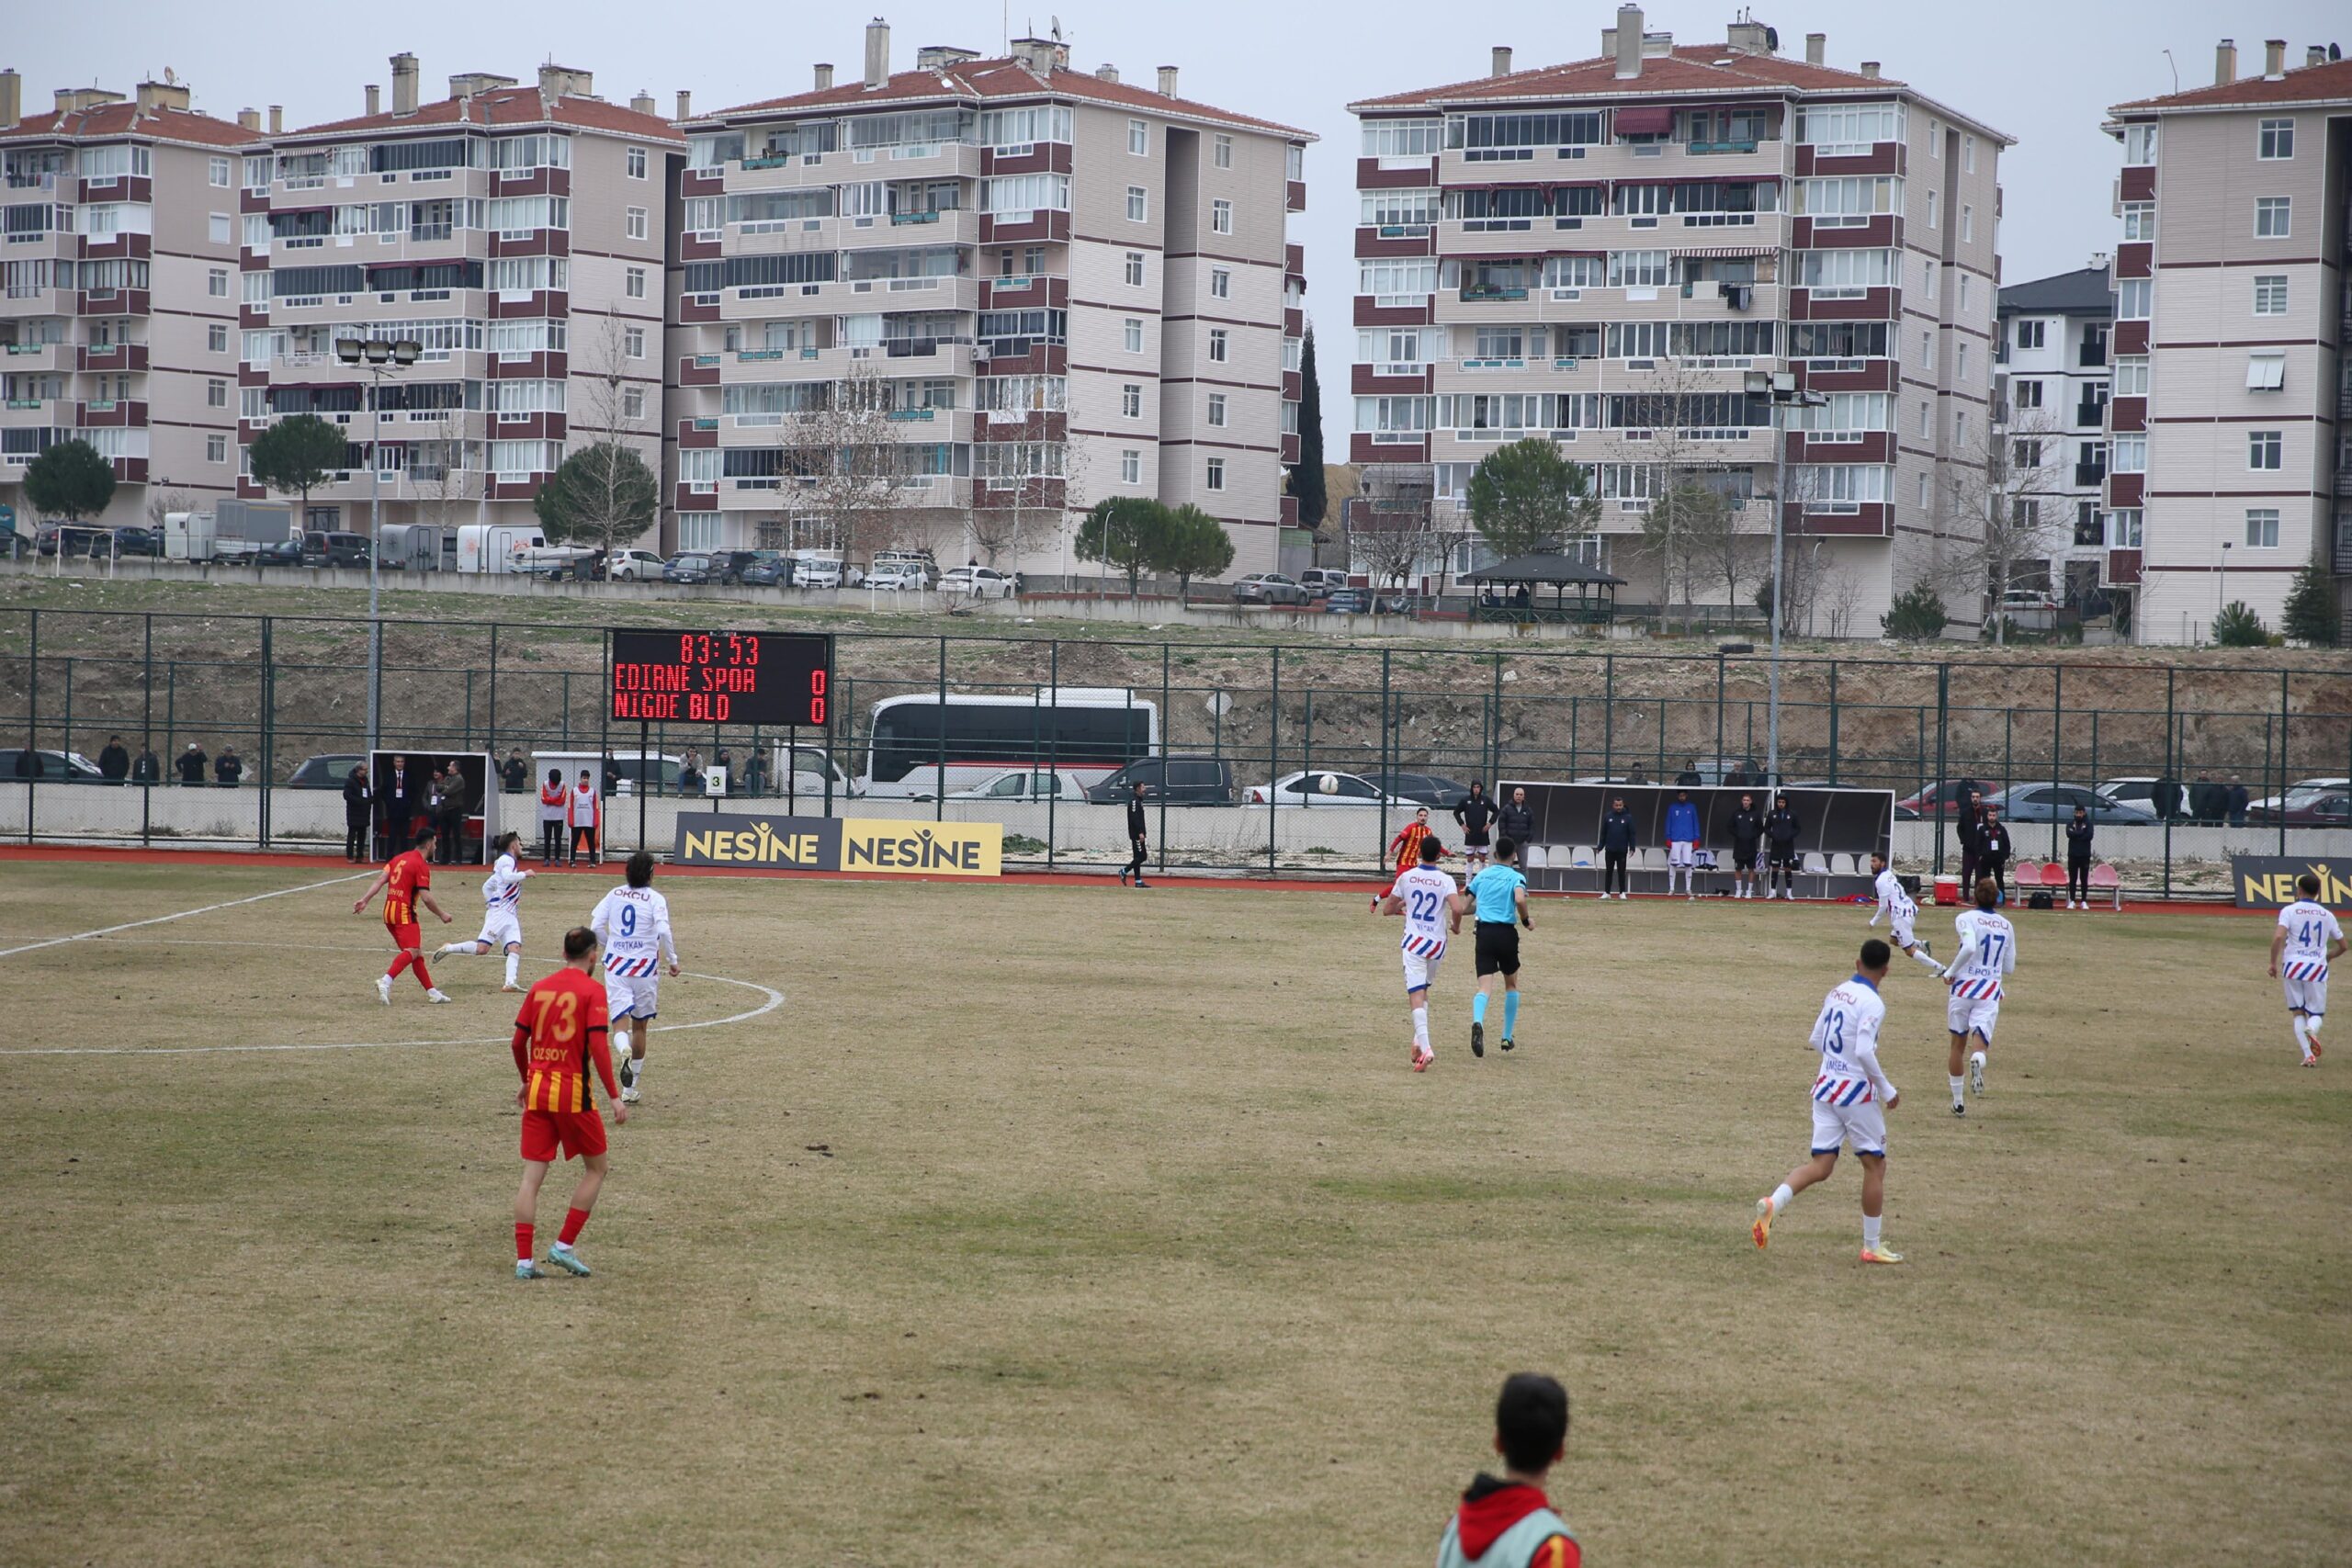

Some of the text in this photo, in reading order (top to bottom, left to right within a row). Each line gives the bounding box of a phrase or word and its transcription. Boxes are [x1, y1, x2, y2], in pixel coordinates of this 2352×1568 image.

[681, 635, 759, 666] 83:53
[615, 664, 826, 695] EDIRNE SPOR 0
[615, 693, 825, 724] NIGDE BLD 0
[711, 776, 720, 787] 3
[390, 860, 407, 885] 5
[620, 904, 636, 937] 9
[1411, 889, 1437, 922] 22
[2299, 920, 2323, 948] 41
[1979, 933, 2006, 967] 17
[532, 990, 578, 1043] 73
[1823, 1008, 1844, 1055] 13
